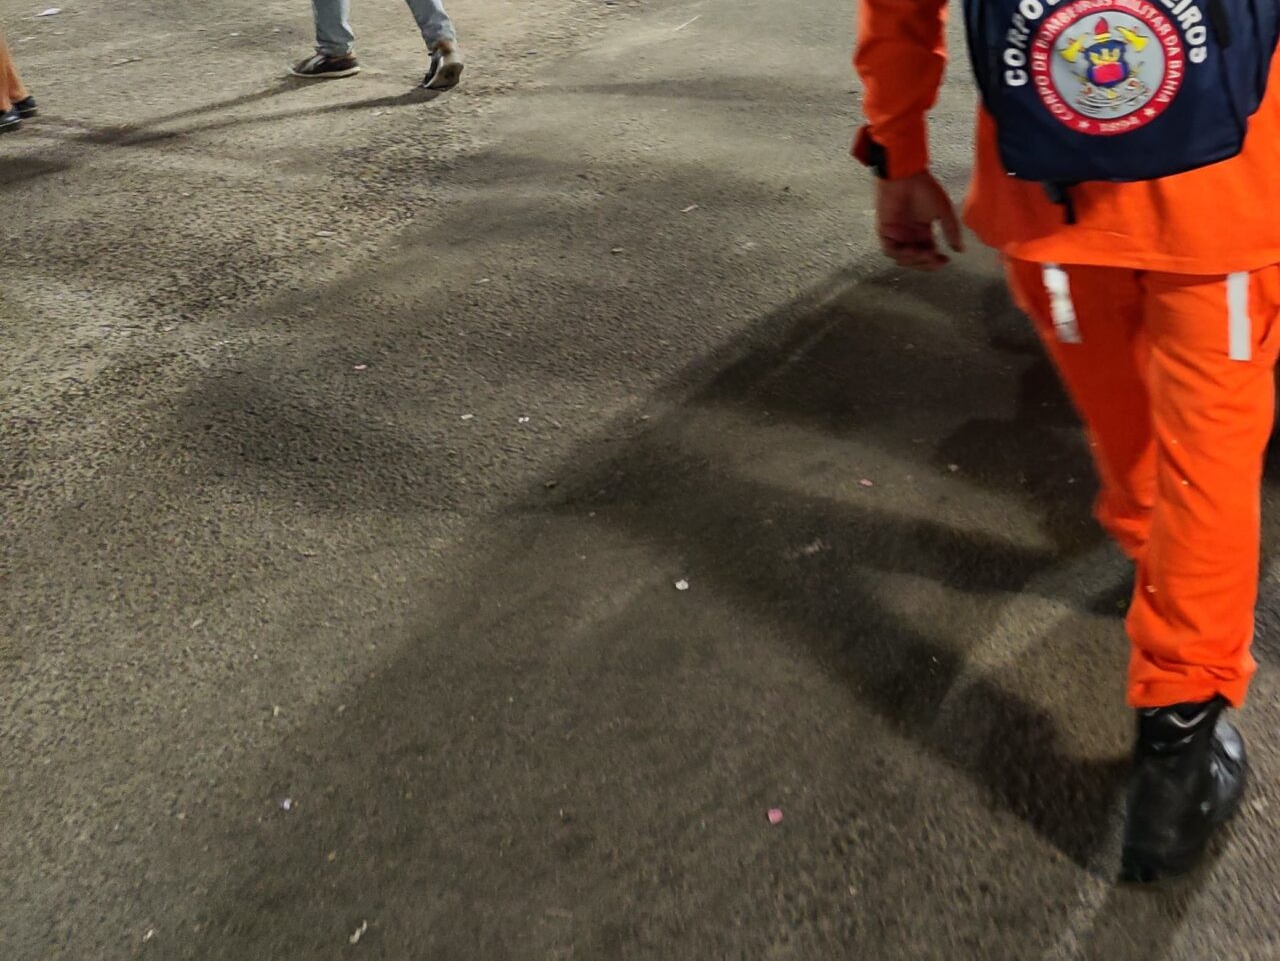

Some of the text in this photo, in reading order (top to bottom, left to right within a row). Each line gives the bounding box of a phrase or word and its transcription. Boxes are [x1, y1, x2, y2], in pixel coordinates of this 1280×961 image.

[1164, 35, 1182, 57] DA
[1031, 51, 1049, 72] DE
[1155, 59, 1183, 103] BAHIA
